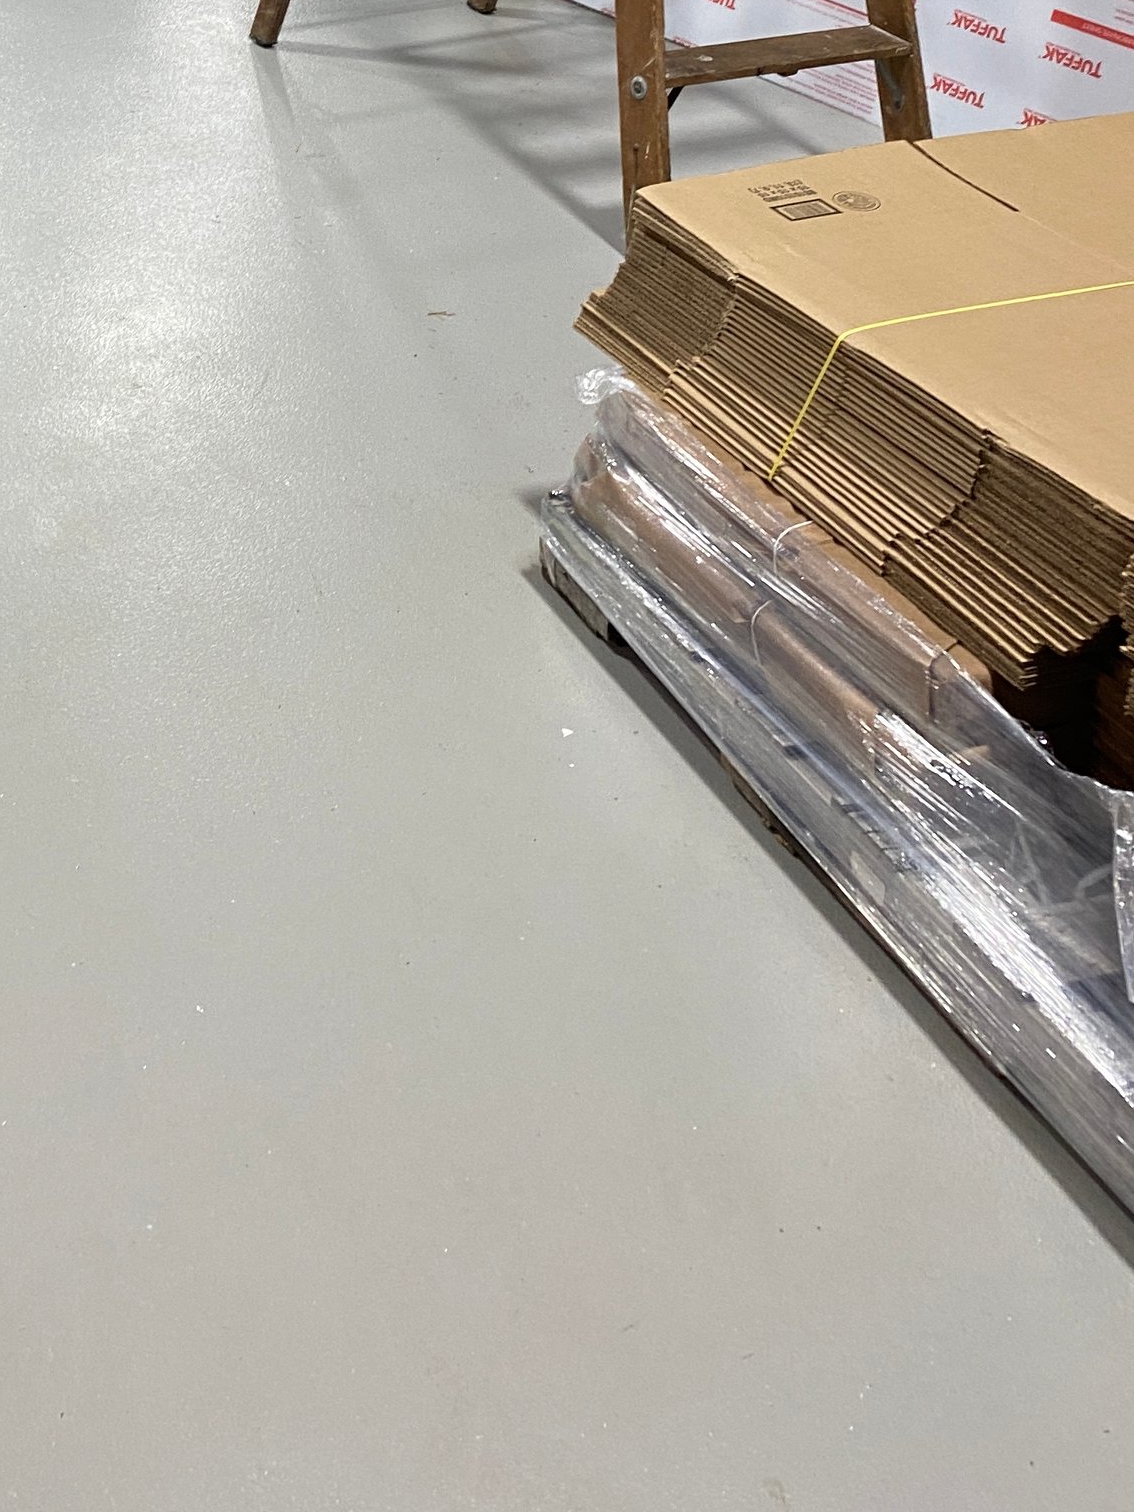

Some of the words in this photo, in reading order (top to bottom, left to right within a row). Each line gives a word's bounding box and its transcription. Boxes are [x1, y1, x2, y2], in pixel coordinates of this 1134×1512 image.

[951, 11, 1007, 44] TUFFAK
[1042, 45, 1104, 79] TUFFAK
[931, 76, 986, 109] TUFFAK
